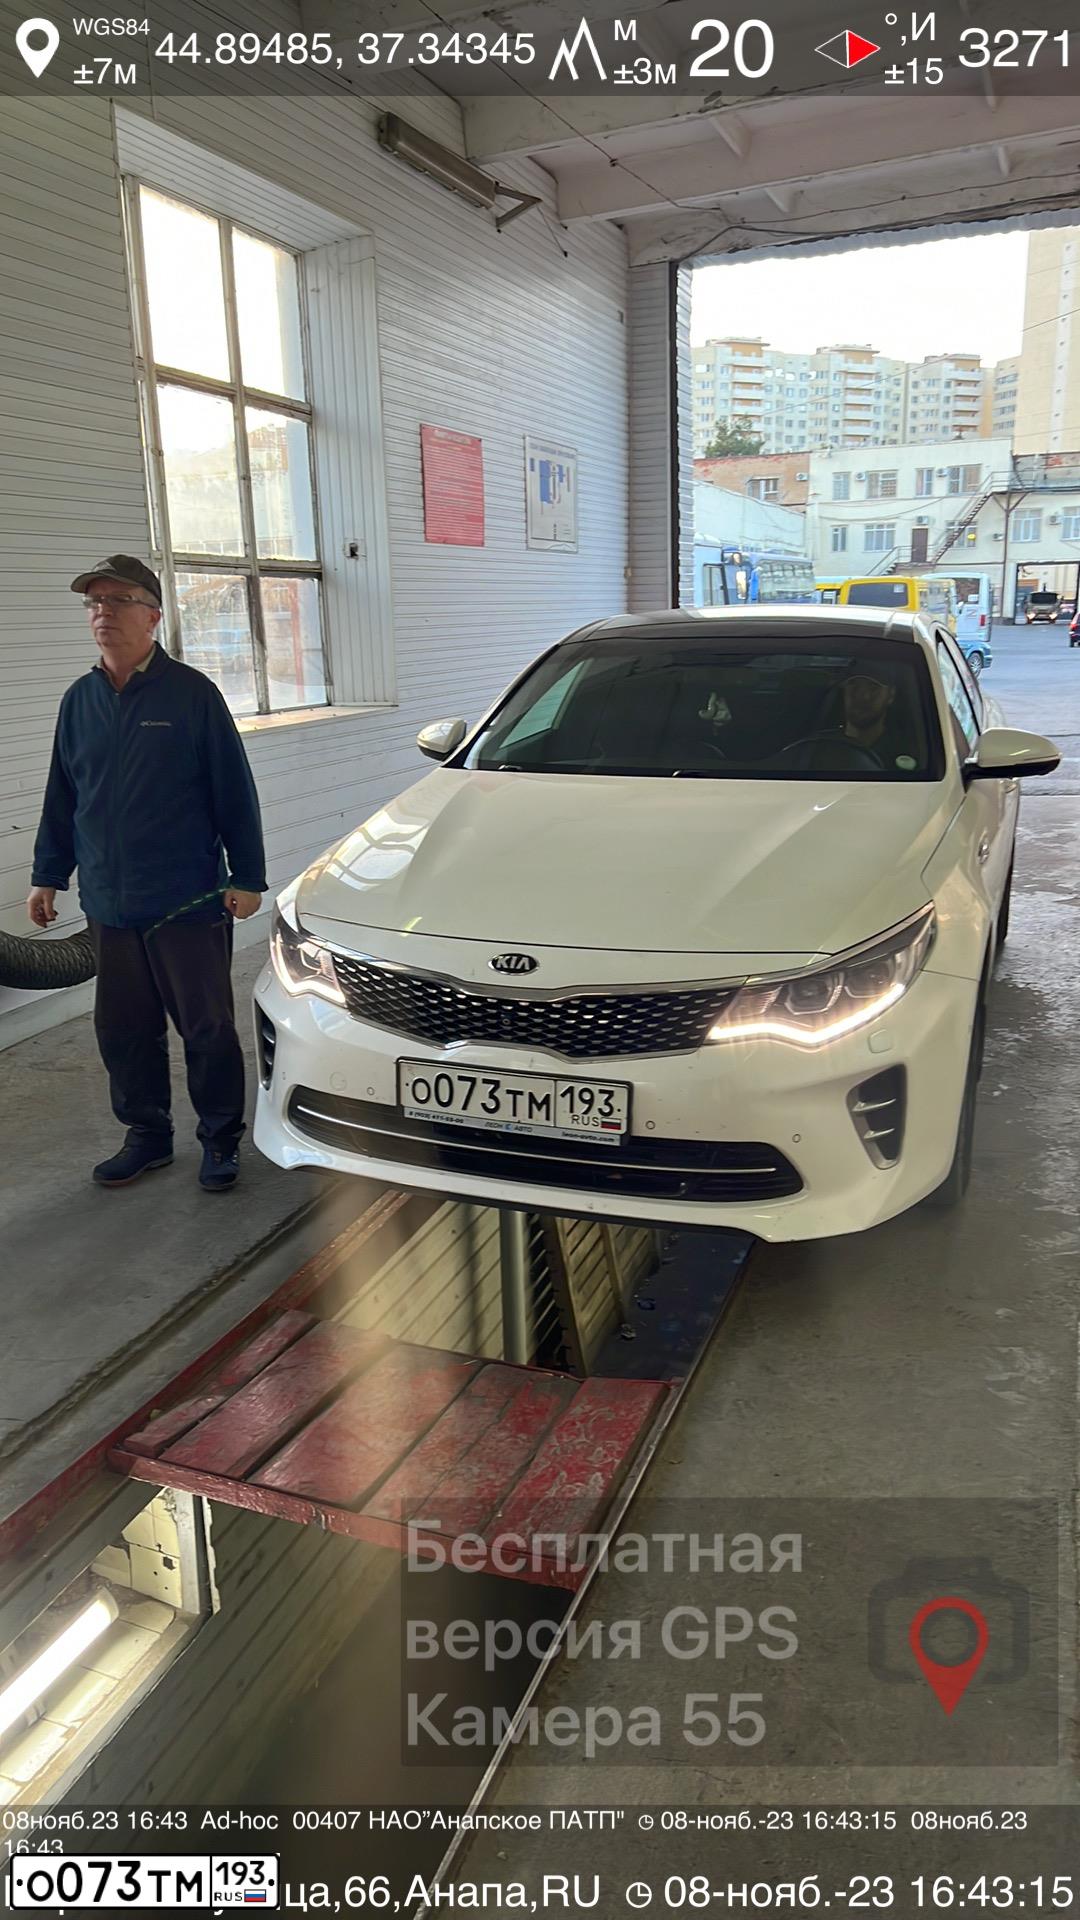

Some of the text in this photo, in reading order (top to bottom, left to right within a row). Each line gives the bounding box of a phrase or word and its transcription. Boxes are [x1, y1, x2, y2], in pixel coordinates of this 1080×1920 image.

[496, 956, 530, 970] KIA
[560, 1086, 615, 1117] 193
[571, 1114, 600, 1127] RUS
